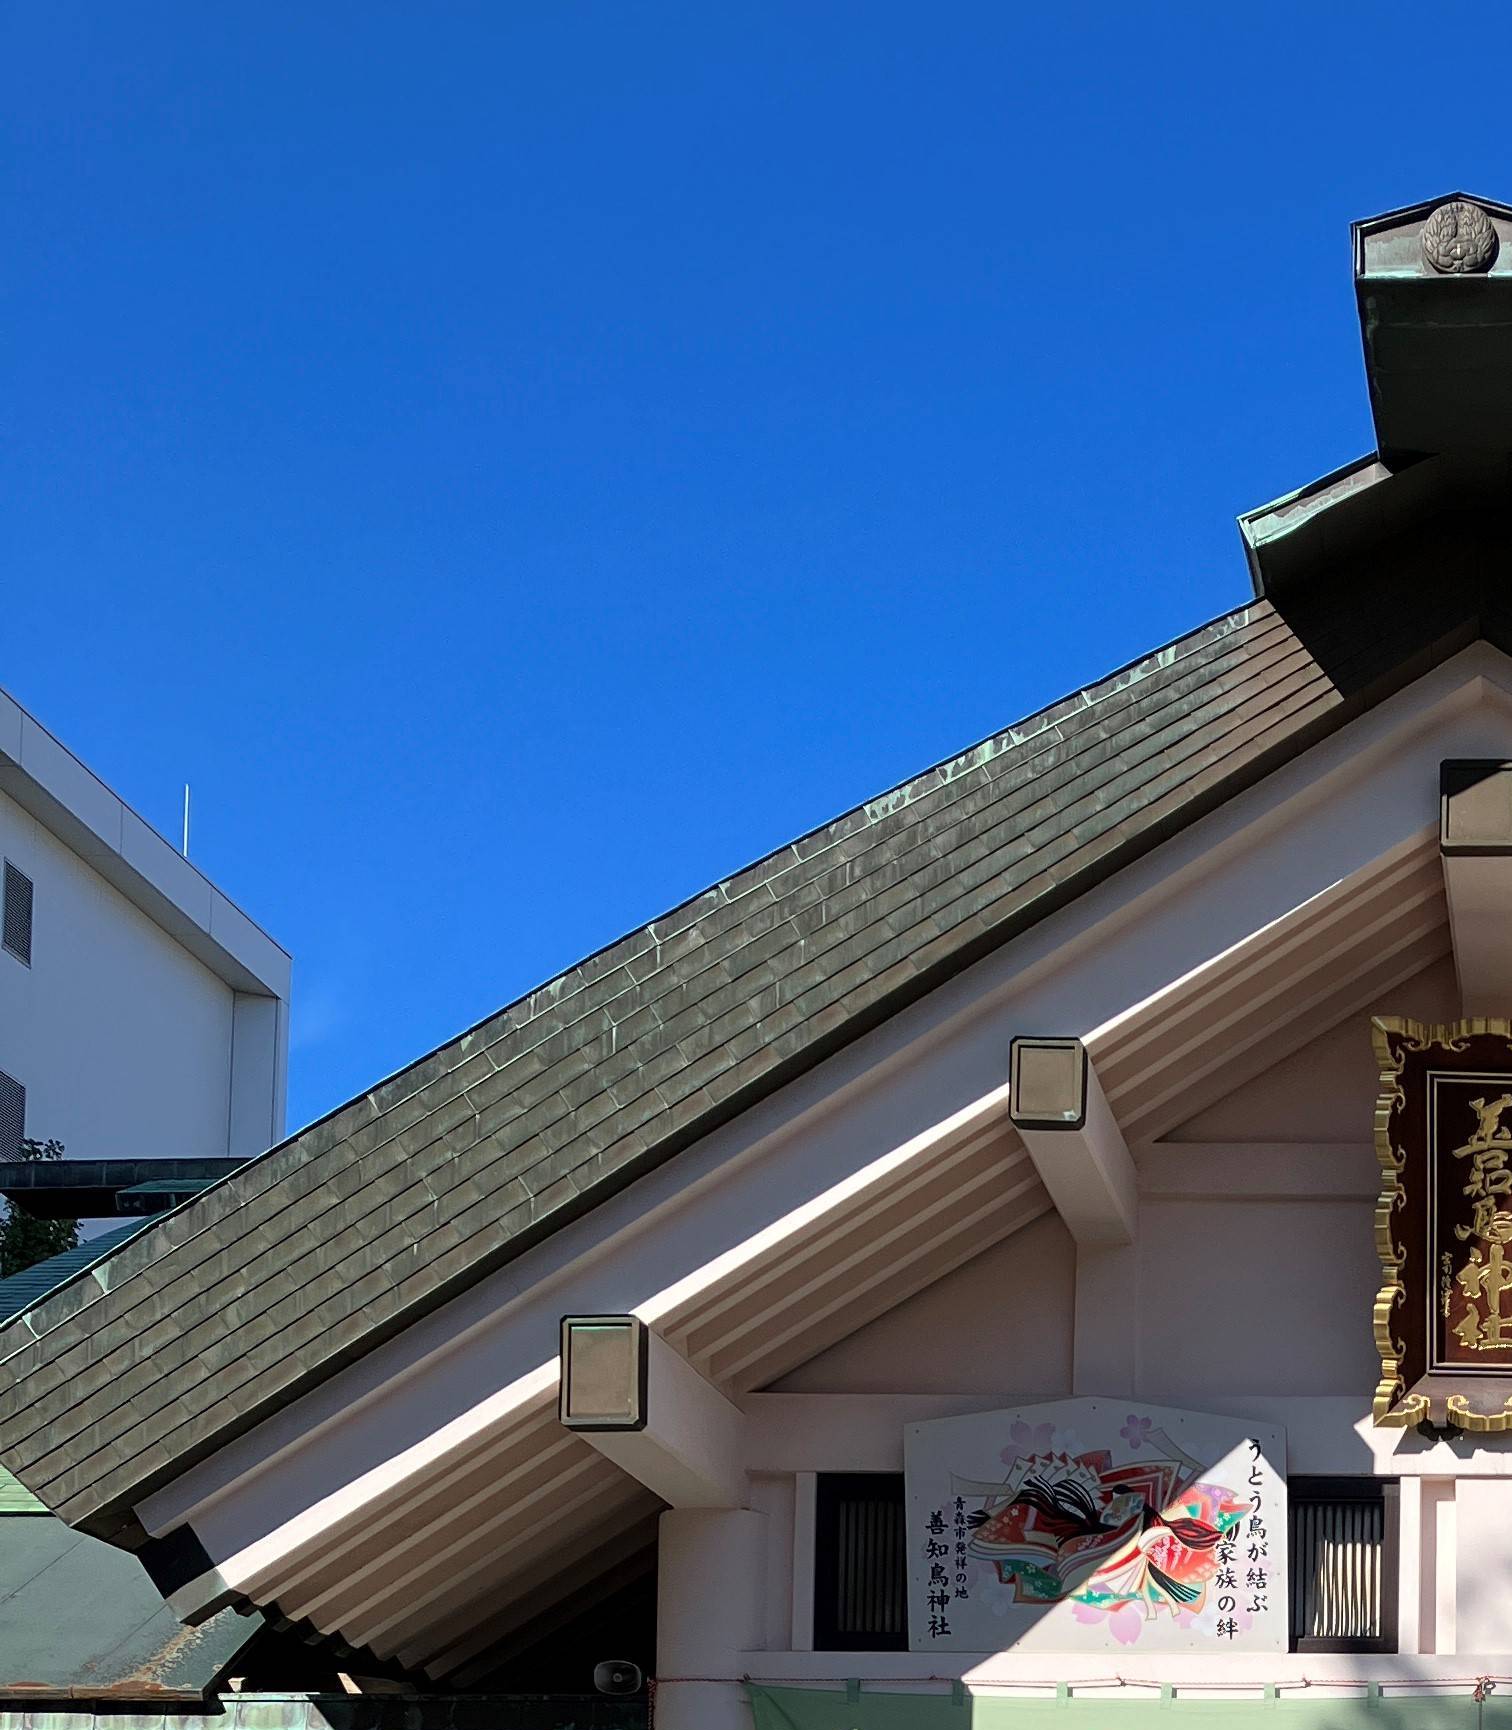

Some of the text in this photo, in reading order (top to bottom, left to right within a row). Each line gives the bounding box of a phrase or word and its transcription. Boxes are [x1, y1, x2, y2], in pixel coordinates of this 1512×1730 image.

[925, 1510, 952, 1639] 善知鳥神社
[952, 1496, 970, 1601] 青森市発祥の地
[1245, 1438, 1269, 1614] うとう鳥が結ぶ
[1214, 1539, 1239, 1640] 家族の絆
